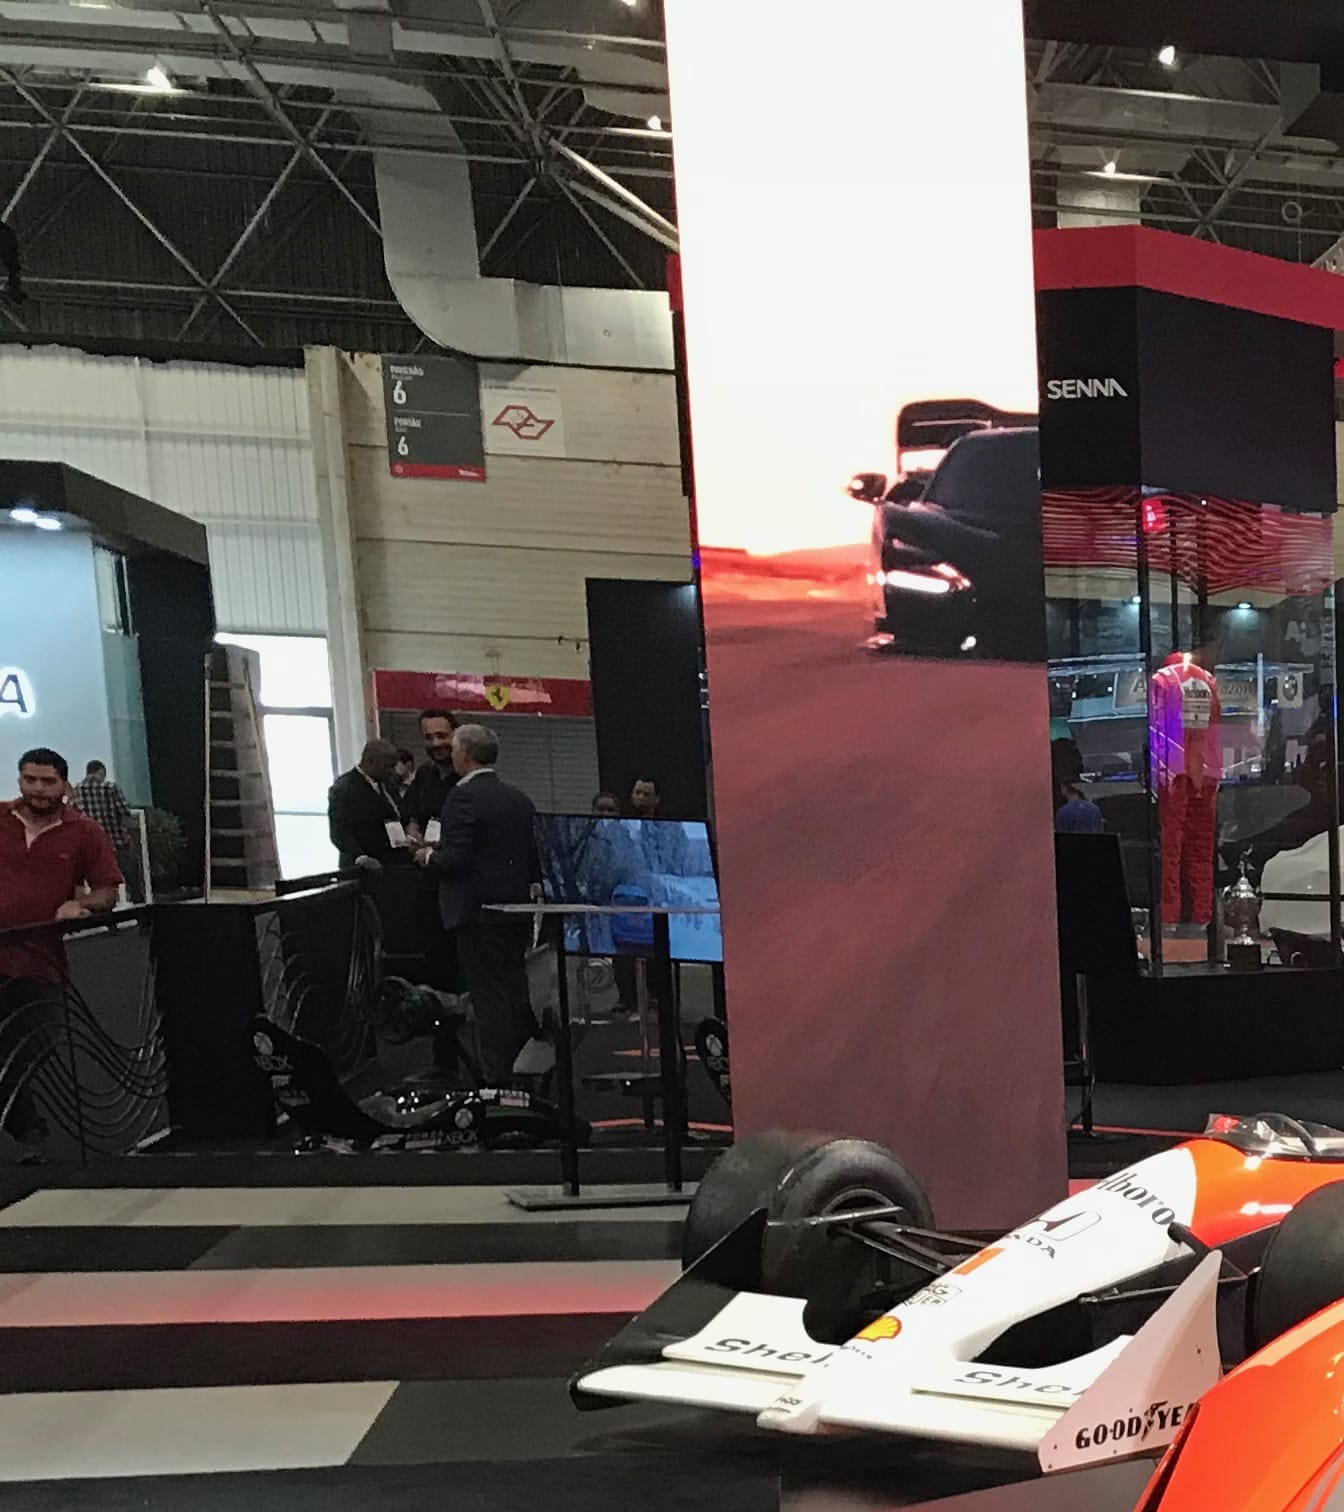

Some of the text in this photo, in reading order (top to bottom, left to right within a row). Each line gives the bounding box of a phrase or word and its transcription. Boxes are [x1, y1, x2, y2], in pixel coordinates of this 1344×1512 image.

[393, 380, 407, 404] 6
[1047, 377, 1128, 399] SENNA
[398, 436, 409, 455] 6
[954, 1370, 1088, 1396] She
[1075, 1403, 1196, 1450] GOODYE
